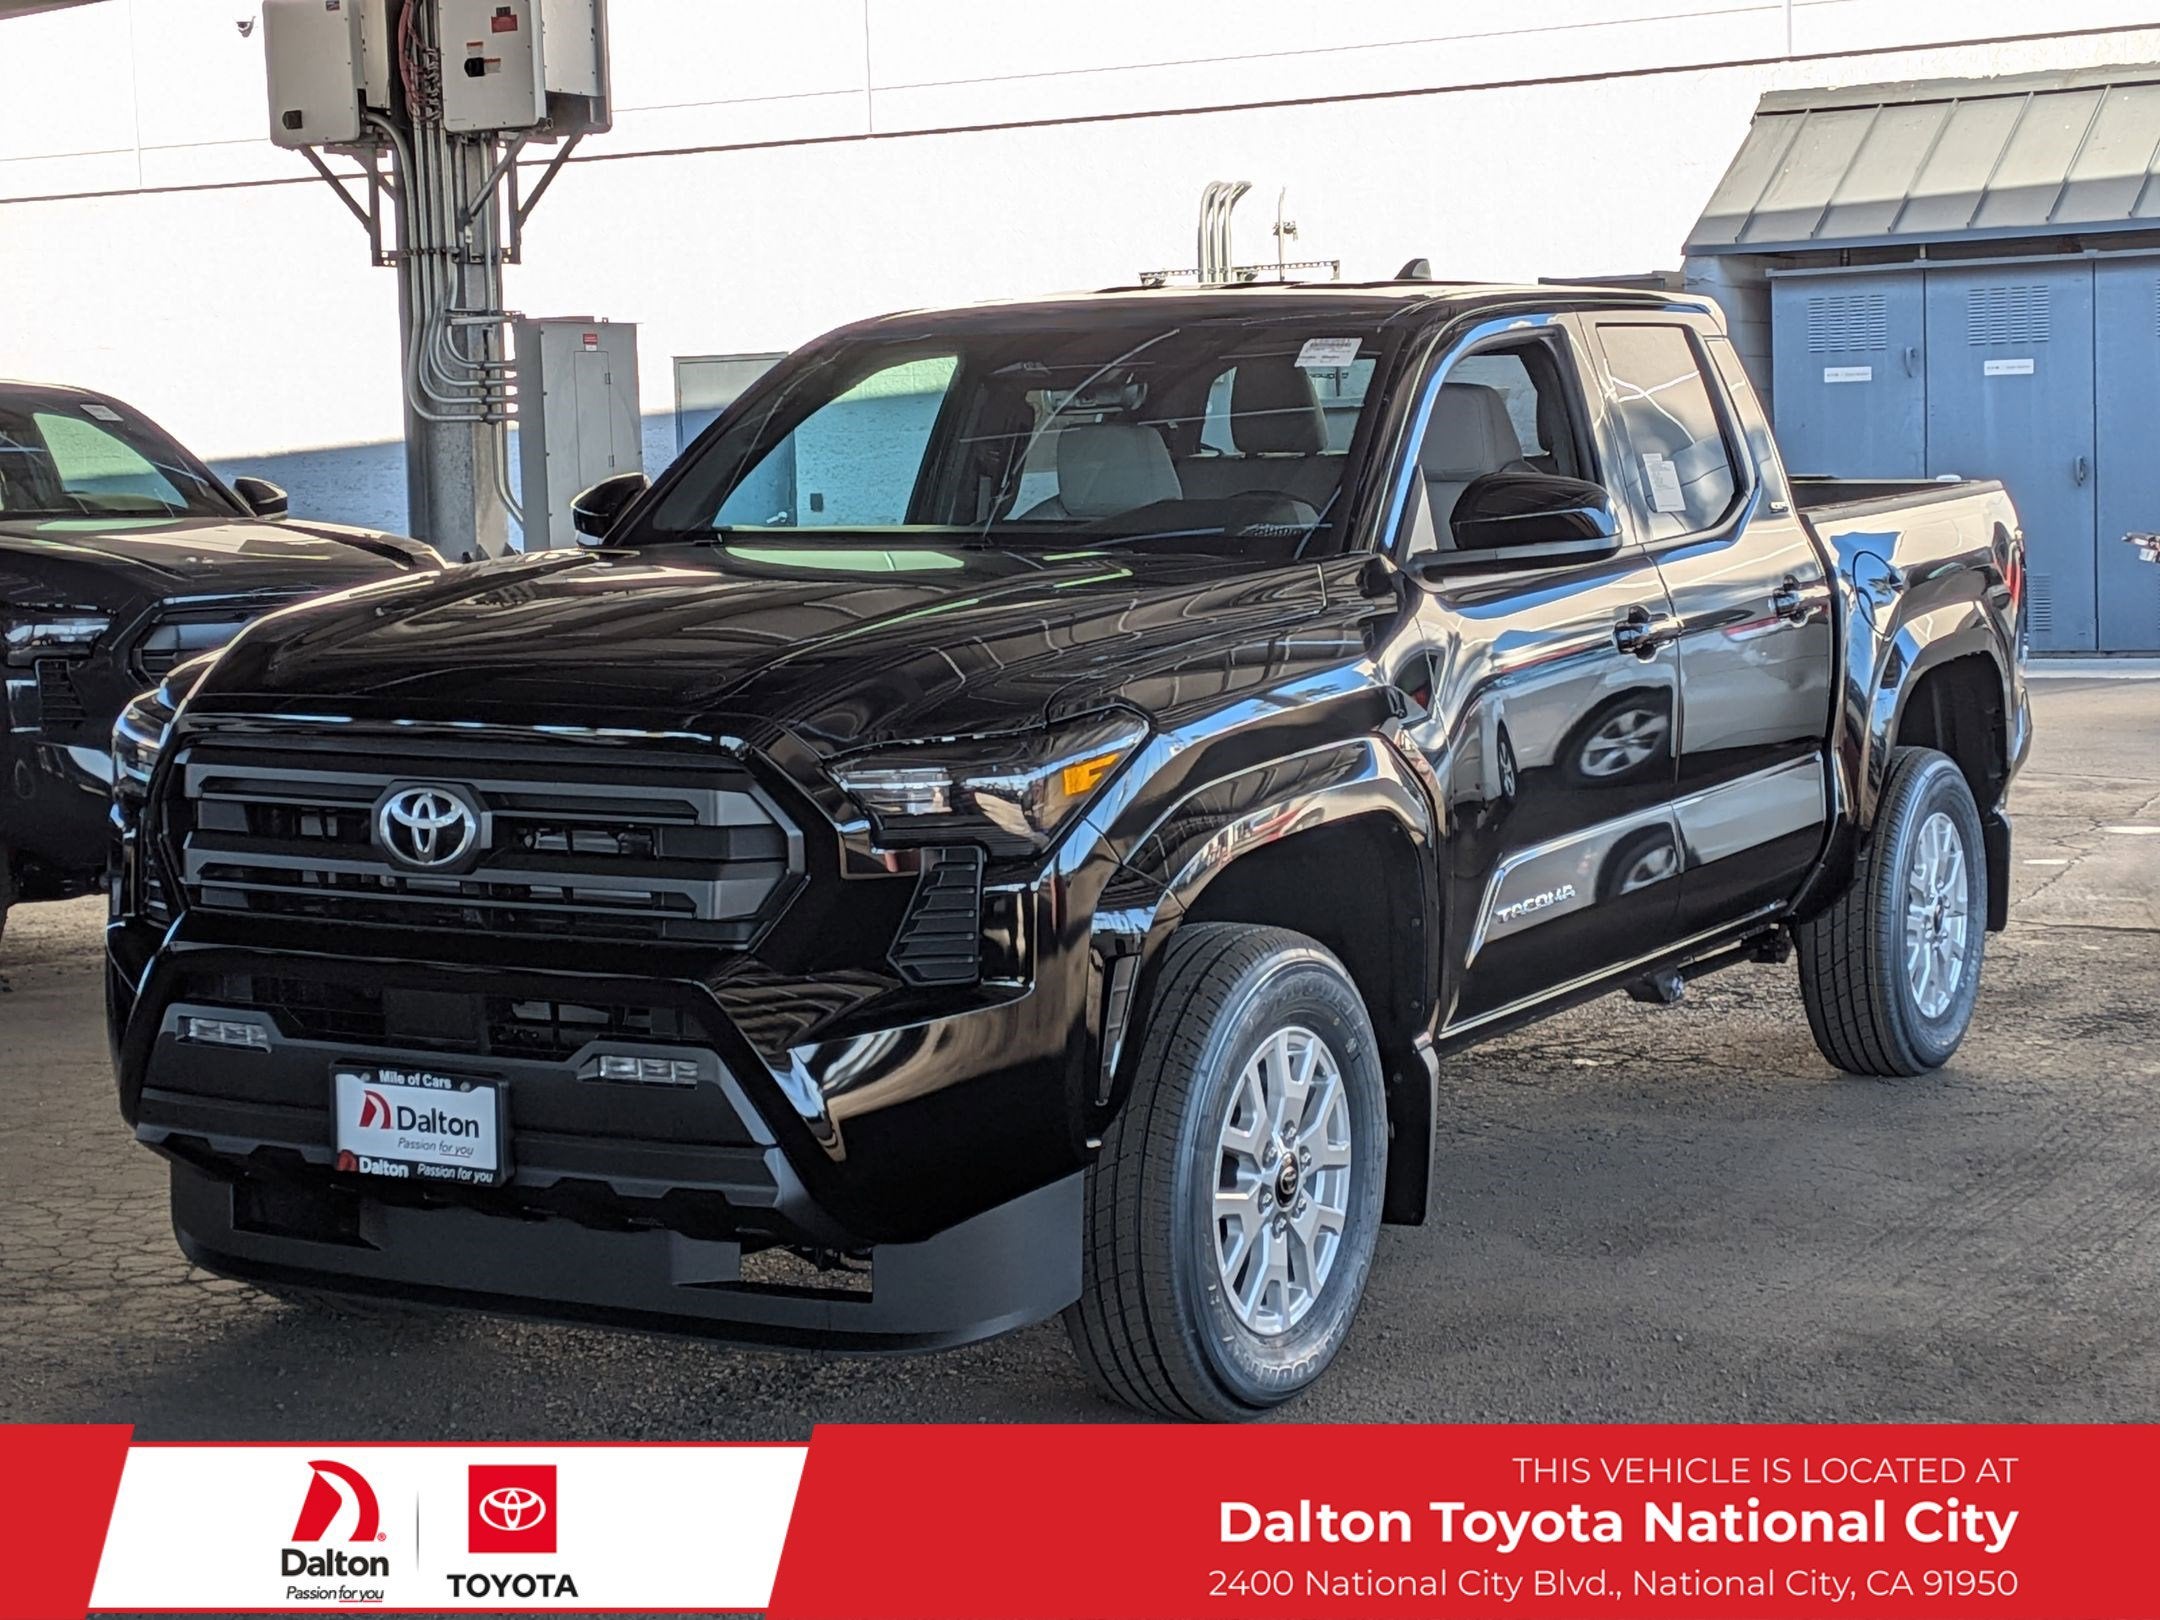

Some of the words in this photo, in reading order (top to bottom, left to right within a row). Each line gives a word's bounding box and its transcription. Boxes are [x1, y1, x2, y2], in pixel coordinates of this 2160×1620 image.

[378, 1069, 406, 1085] Mile
[407, 1072, 421, 1086] of
[422, 1073, 452, 1089] Cars
[396, 1105, 479, 1138] Dalton
[398, 1136, 436, 1151] Passion
[439, 1140, 453, 1152] for
[455, 1145, 474, 1156] you
[359, 1156, 409, 1179] Dalton
[416, 1162, 456, 1179] Passion
[456, 1166, 472, 1181] for
[473, 1171, 494, 1184] you
